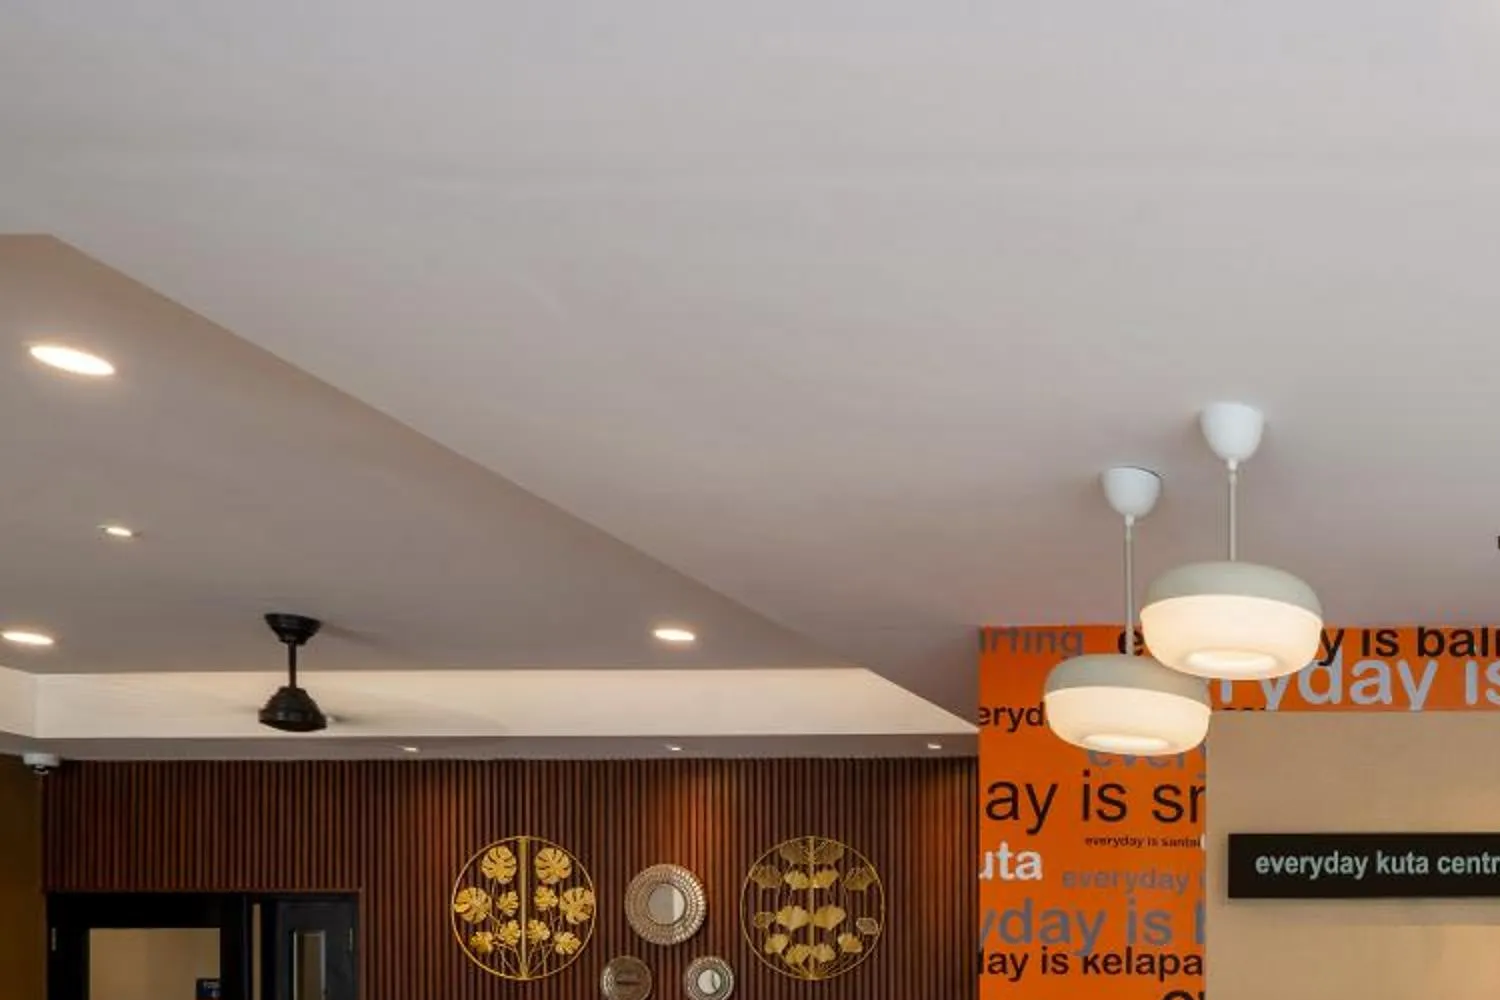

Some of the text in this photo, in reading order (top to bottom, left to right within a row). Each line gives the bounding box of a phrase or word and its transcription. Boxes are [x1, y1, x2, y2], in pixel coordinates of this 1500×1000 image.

[985, 781, 1058, 835] ay
[1082, 769, 1127, 822] is
[1255, 851, 1369, 880] everyday
[1376, 850, 1429, 875] kuta
[1062, 868, 1189, 894] everyday
[1127, 897, 1173, 945] is
[1041, 945, 1069, 975] is
